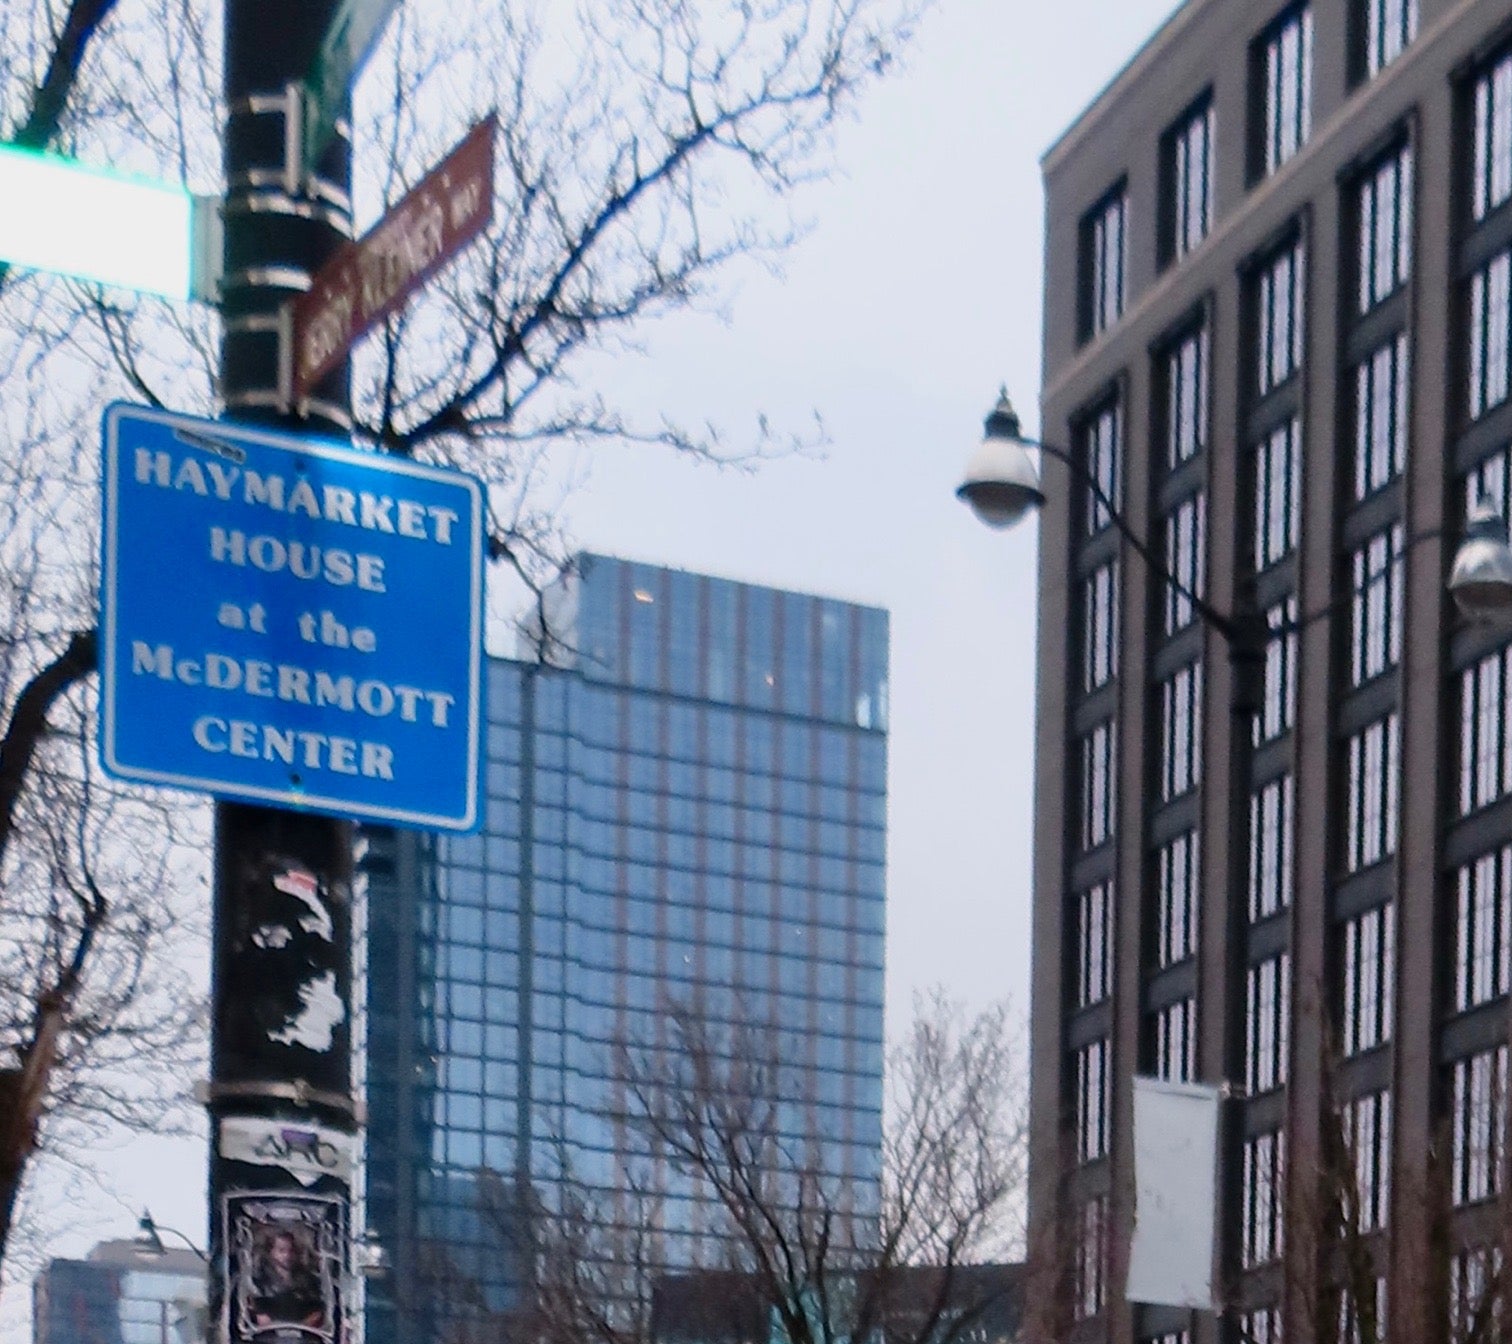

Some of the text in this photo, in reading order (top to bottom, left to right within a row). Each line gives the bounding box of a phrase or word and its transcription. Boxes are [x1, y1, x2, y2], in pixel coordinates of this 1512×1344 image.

[134, 446, 459, 545] HAYMARKET
[209, 525, 387, 594] HOUSE
[216, 602, 377, 653] at the
[131, 640, 456, 729] McDERMOTT
[192, 715, 395, 782] CENTER
